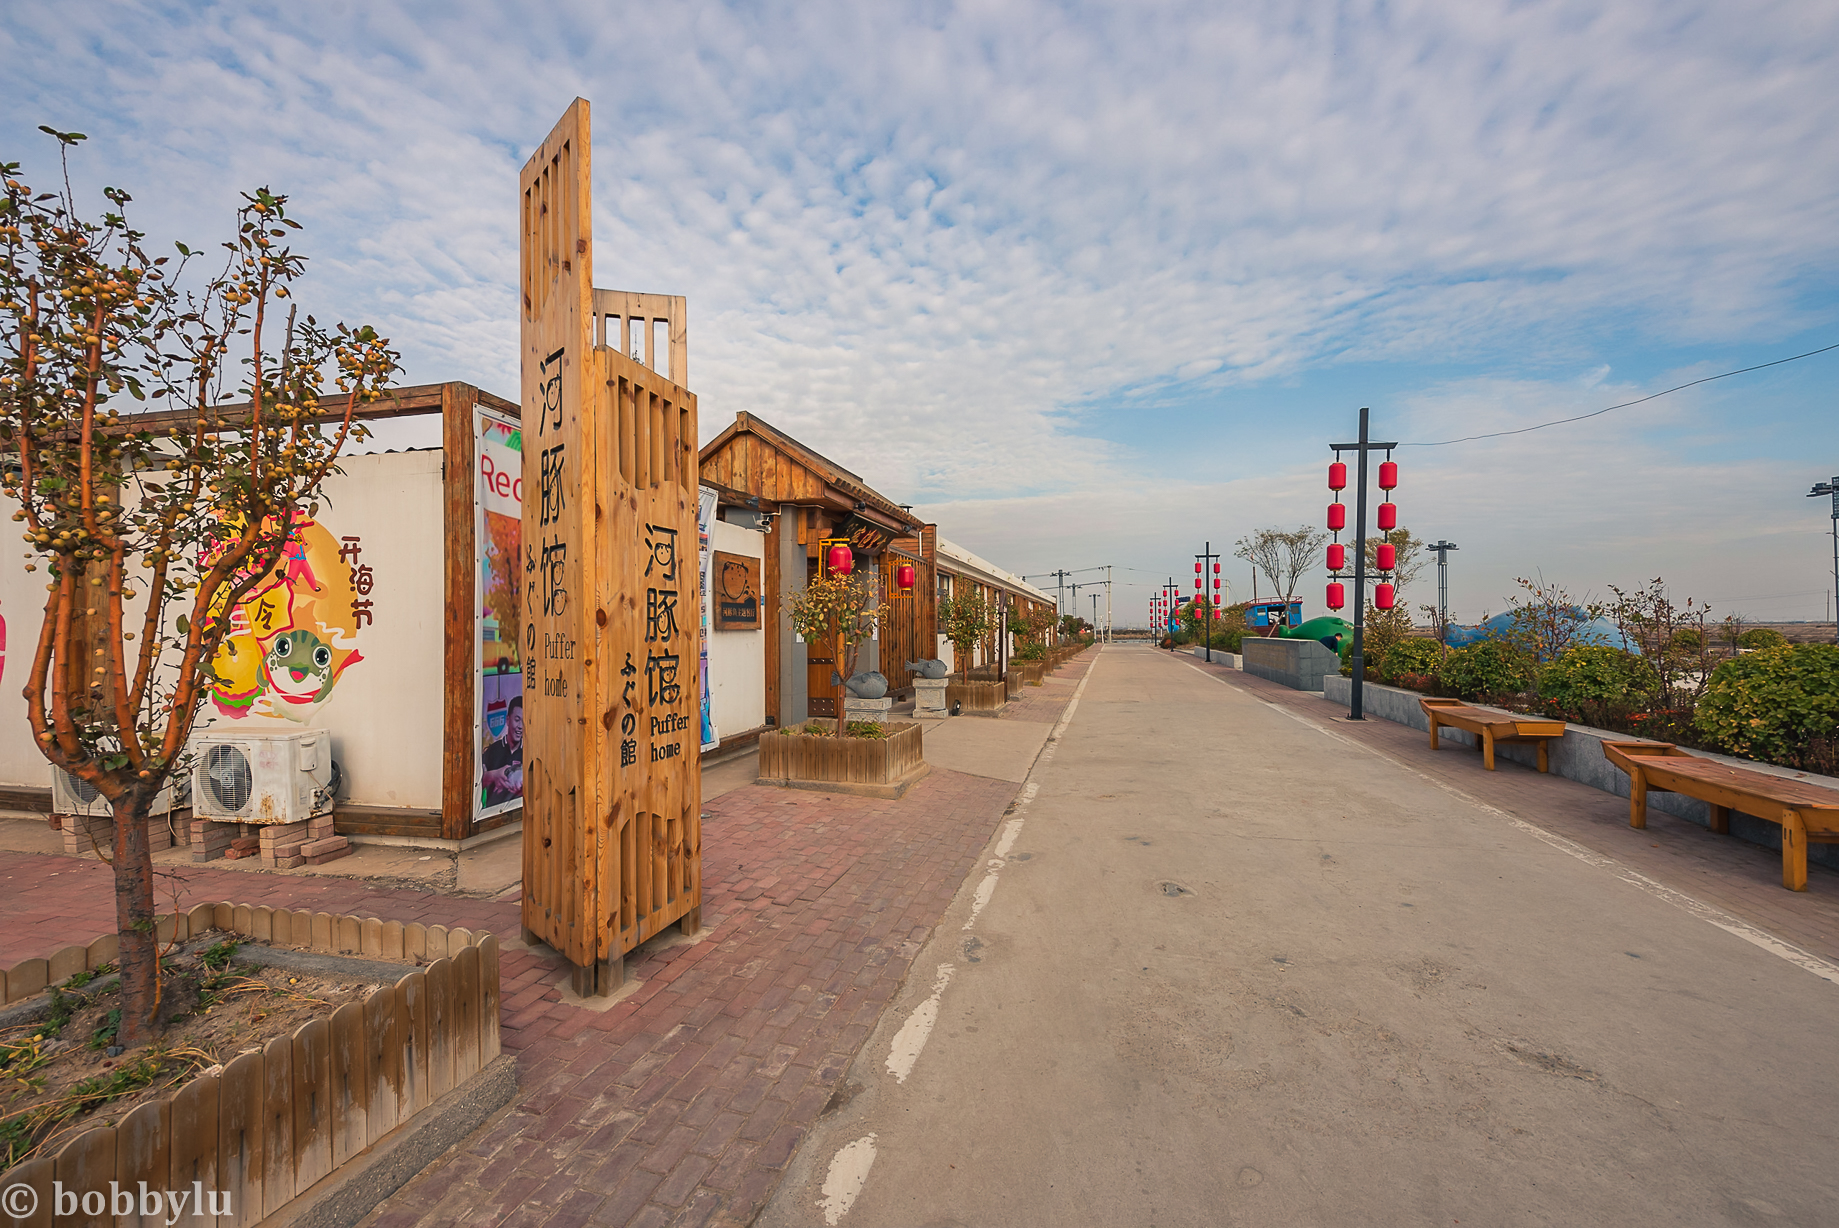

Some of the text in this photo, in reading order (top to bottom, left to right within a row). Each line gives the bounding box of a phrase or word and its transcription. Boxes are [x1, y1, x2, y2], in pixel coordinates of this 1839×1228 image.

[539, 346, 567, 617] 河豚馆
[338, 535, 374, 630] 开海节
[544, 632, 576, 660] Puffer
[644, 522, 680, 708] 河豚馆
[544, 669, 568, 698] home
[620, 652, 637, 769] ふぐの館
[650, 712, 690, 738] Puffer
[650, 740, 682, 763] home
